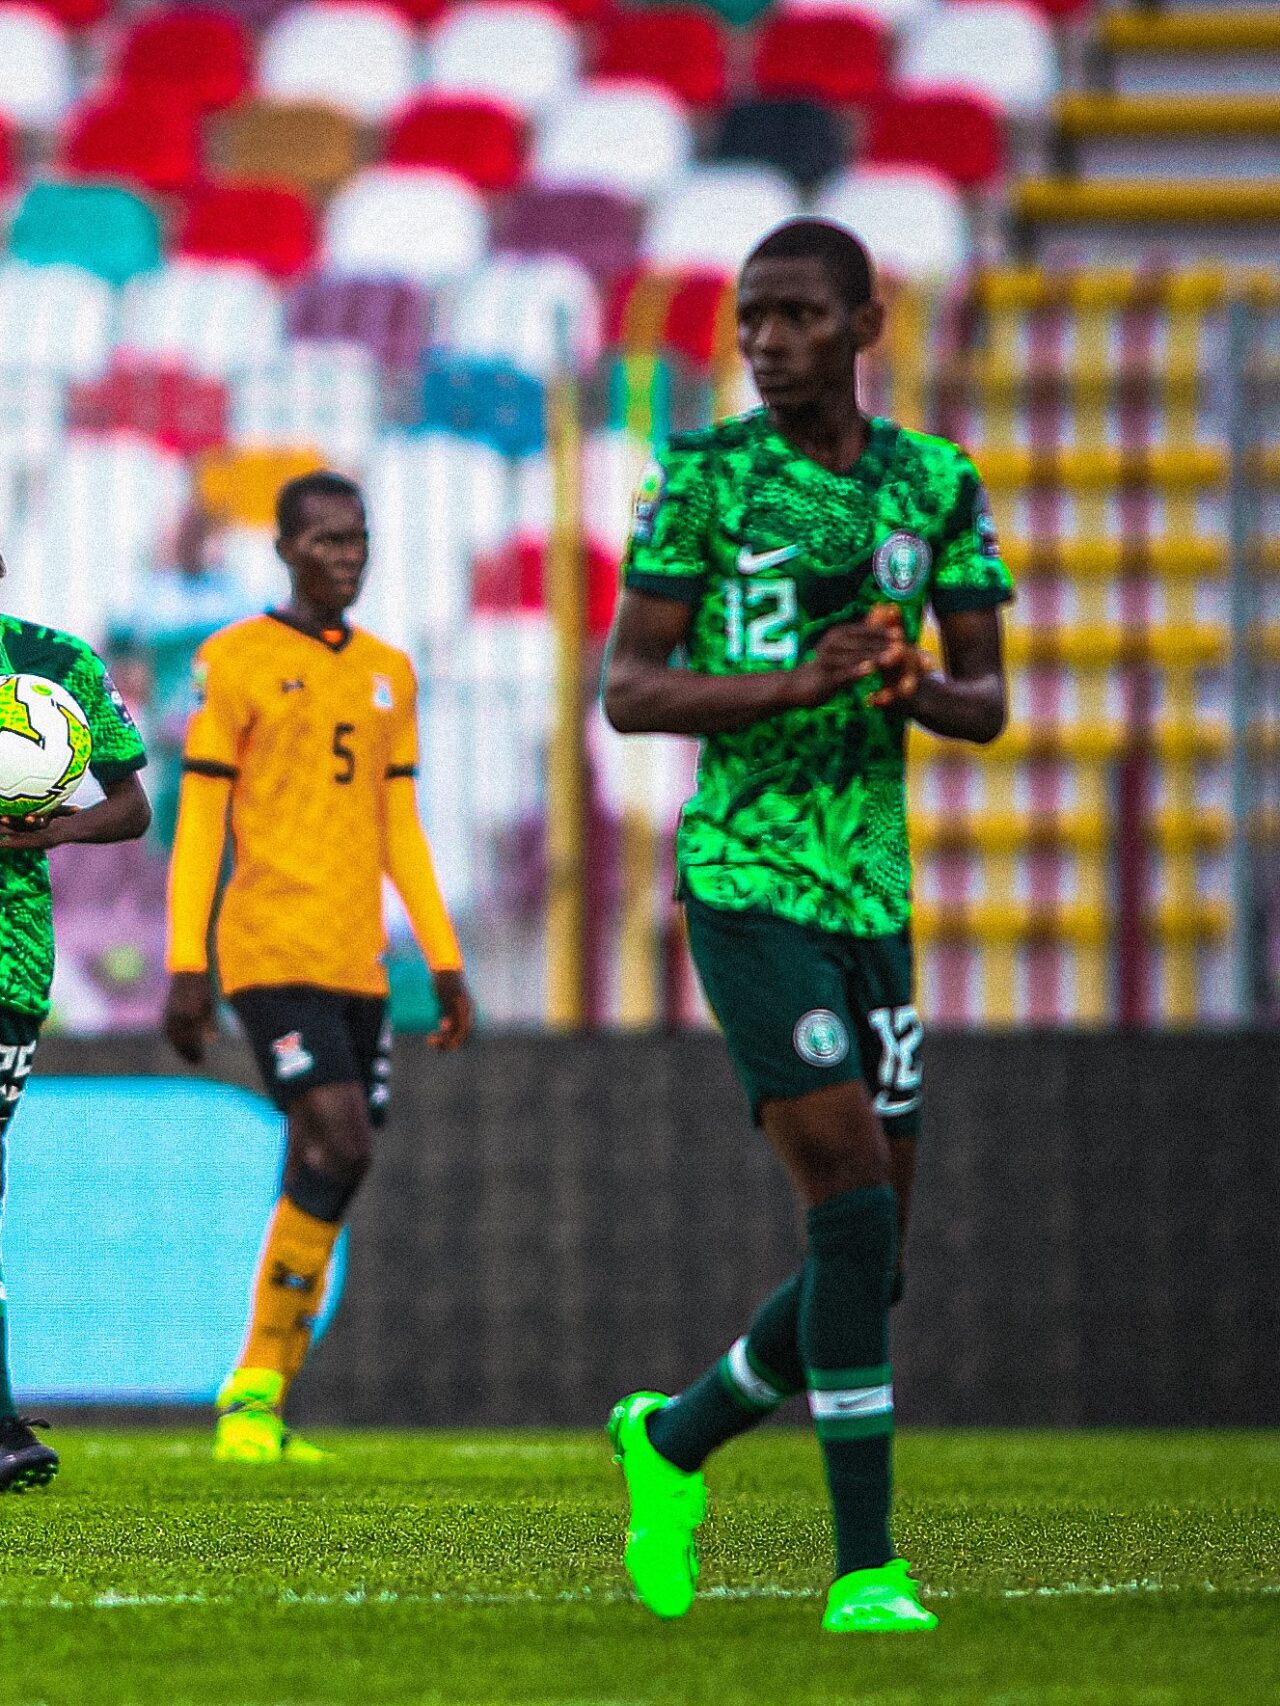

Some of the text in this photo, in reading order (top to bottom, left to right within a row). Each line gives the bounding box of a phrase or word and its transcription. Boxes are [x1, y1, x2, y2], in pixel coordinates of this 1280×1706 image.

[721, 578, 798, 662] 12
[332, 721, 355, 786] 5
[868, 1003, 924, 1092] 12
